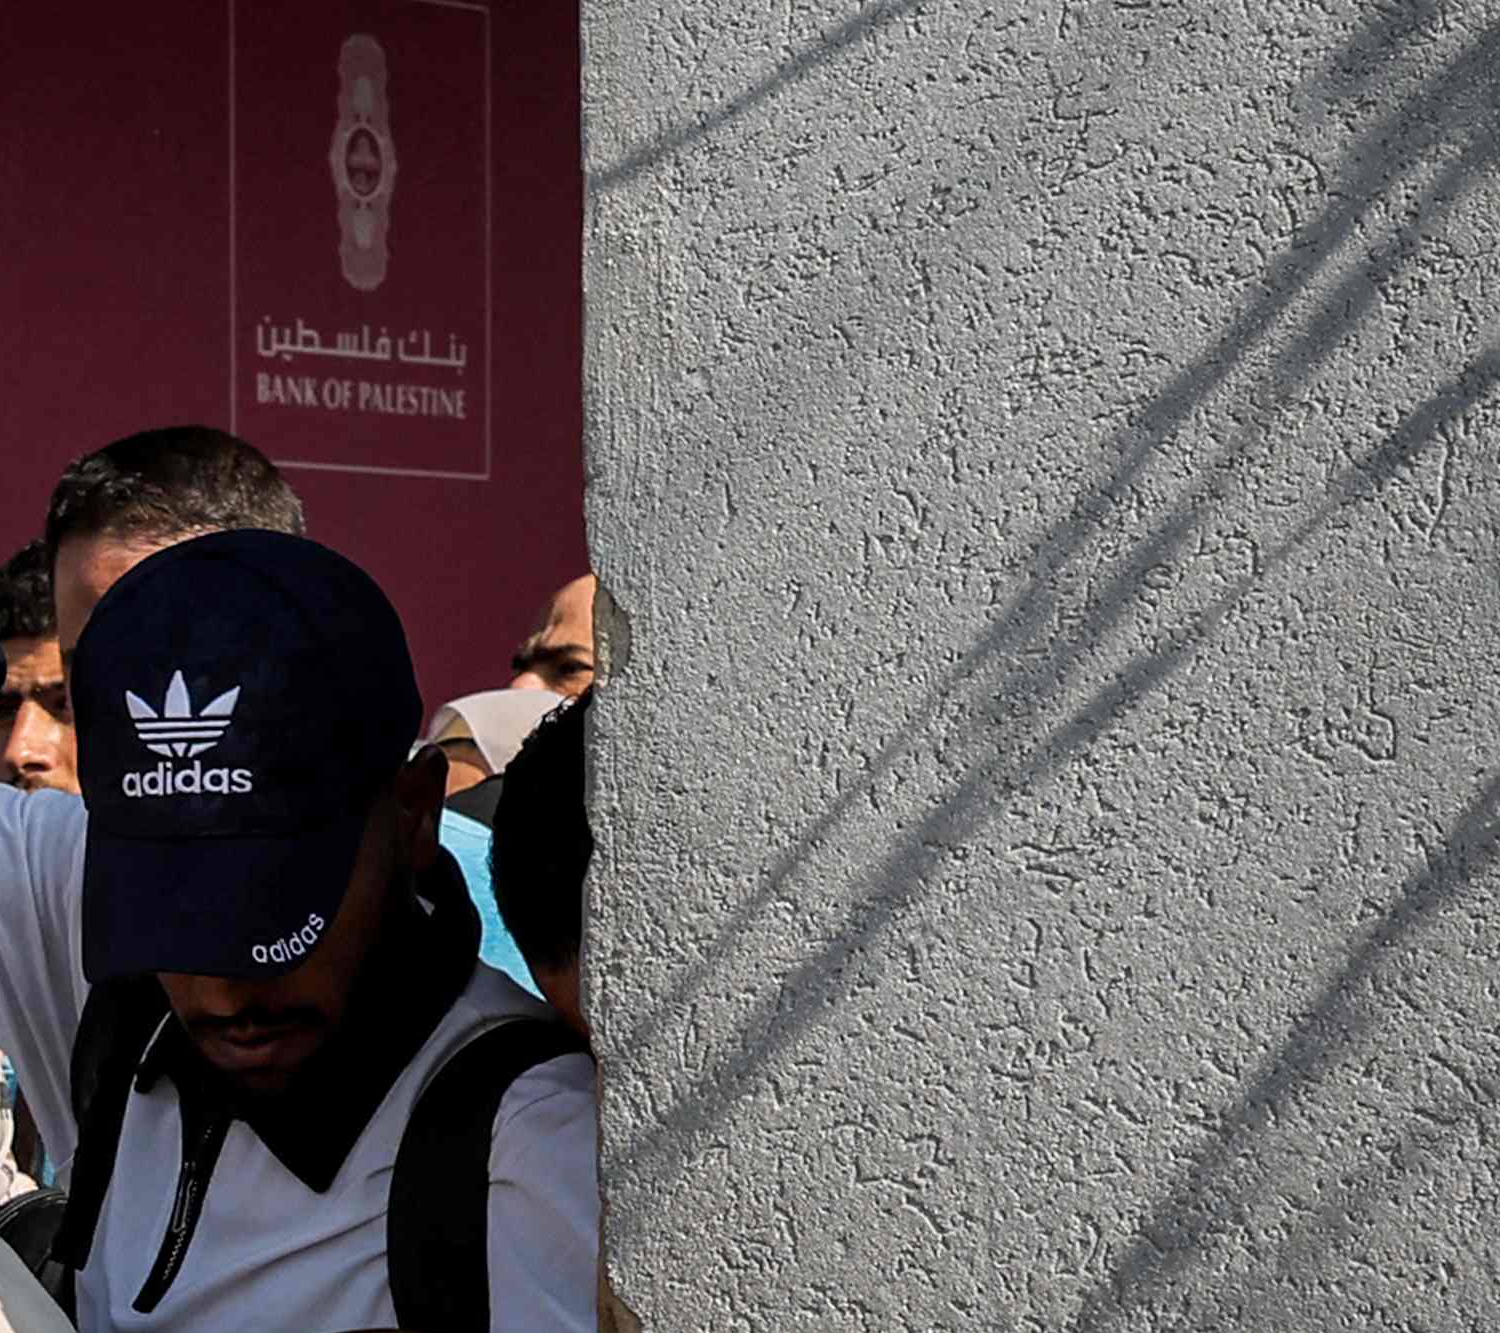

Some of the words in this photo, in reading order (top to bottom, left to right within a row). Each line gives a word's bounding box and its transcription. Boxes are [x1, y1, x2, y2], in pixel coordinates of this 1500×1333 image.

[256, 315, 392, 362] فلسطين
[397, 330, 468, 376] بنك
[256, 372, 319, 408] BANK
[322, 378, 353, 410] OF
[358, 381, 468, 420] PALESTINE
[122, 760, 253, 798] adidas
[252, 913, 325, 964] adidas
